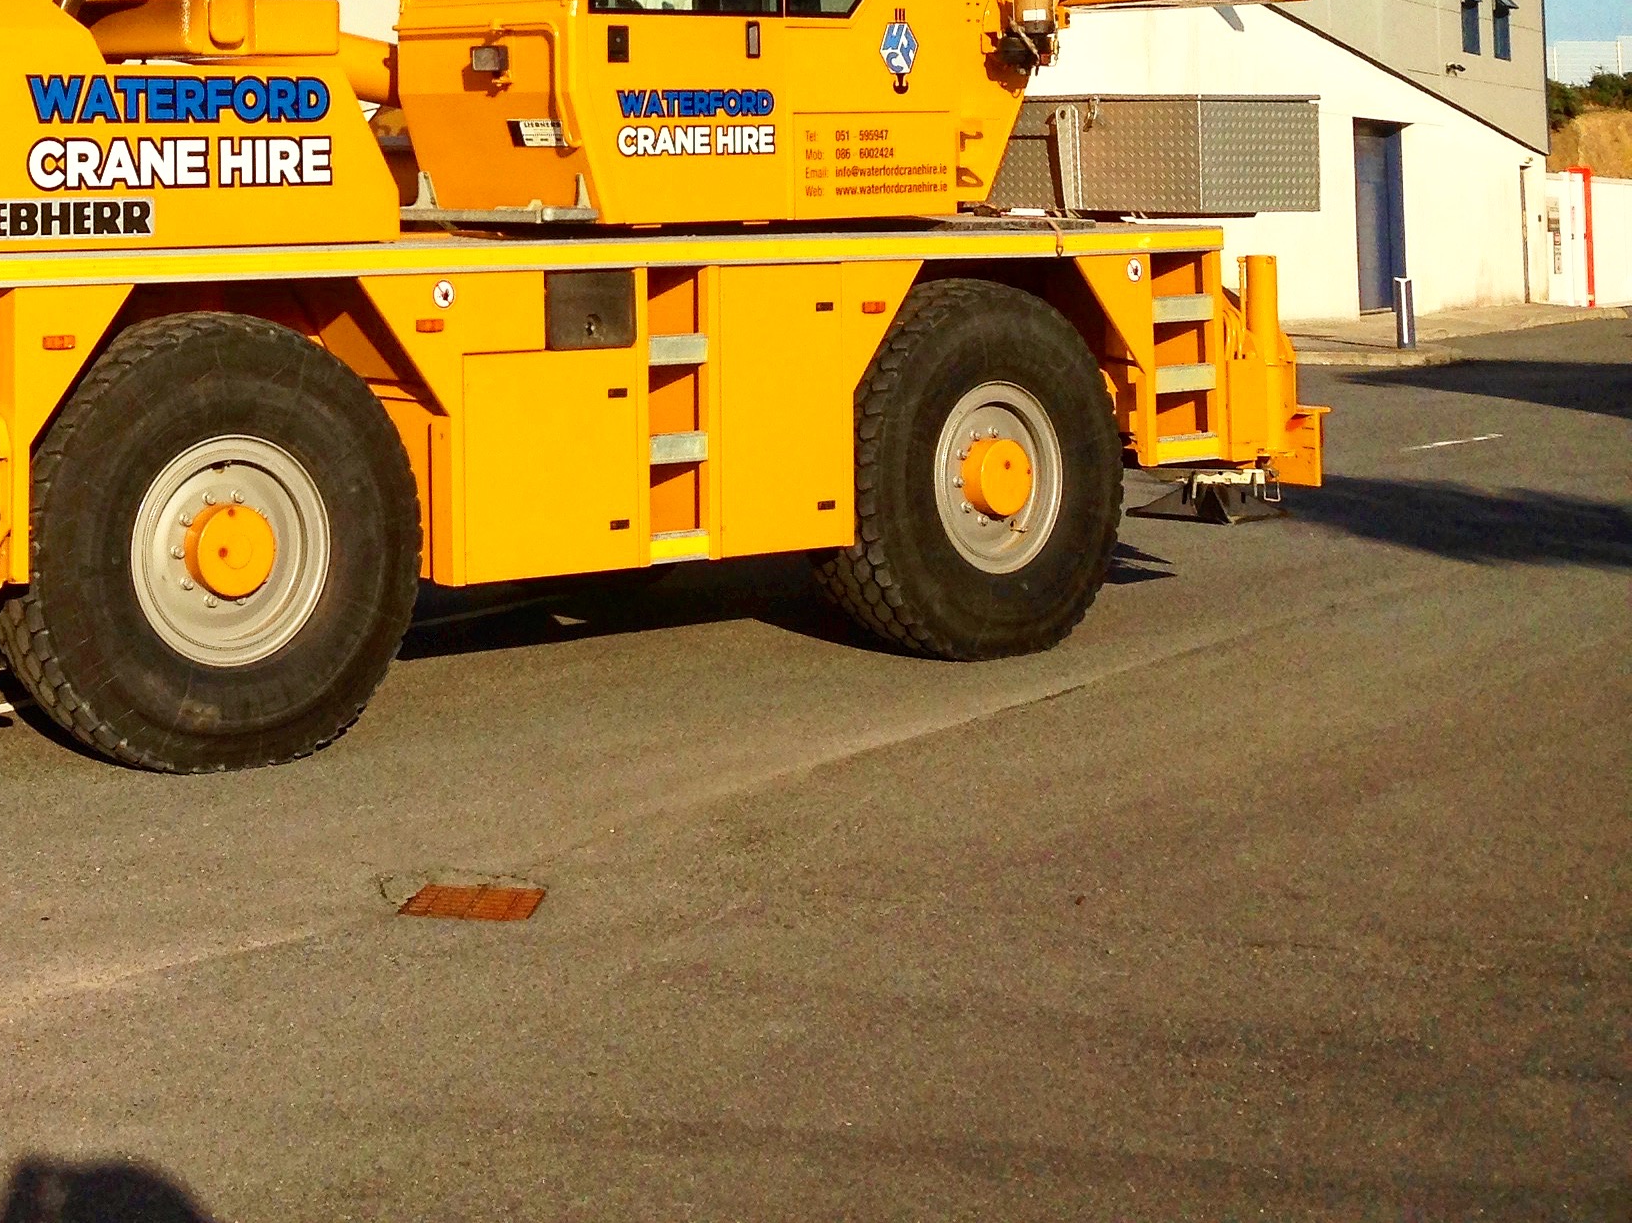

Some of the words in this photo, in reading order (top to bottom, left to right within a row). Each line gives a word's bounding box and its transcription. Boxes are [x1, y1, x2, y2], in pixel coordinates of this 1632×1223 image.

[26, 74, 332, 124] WATERFORD
[616, 89, 775, 118] WATERFORD
[617, 125, 712, 157] CRANE
[716, 124, 776, 155] HIRE
[835, 130, 850, 142] 051
[27, 137, 210, 192] CRANE
[218, 136, 333, 189] HIRE
[805, 149, 825, 161] Mob:
[805, 166, 829, 179] Email:
[835, 163, 948, 179] info@waterfordcranehire.ie
[805, 185, 825, 197] Web:
[835, 182, 948, 196] www.waterfordcranehire.ie
